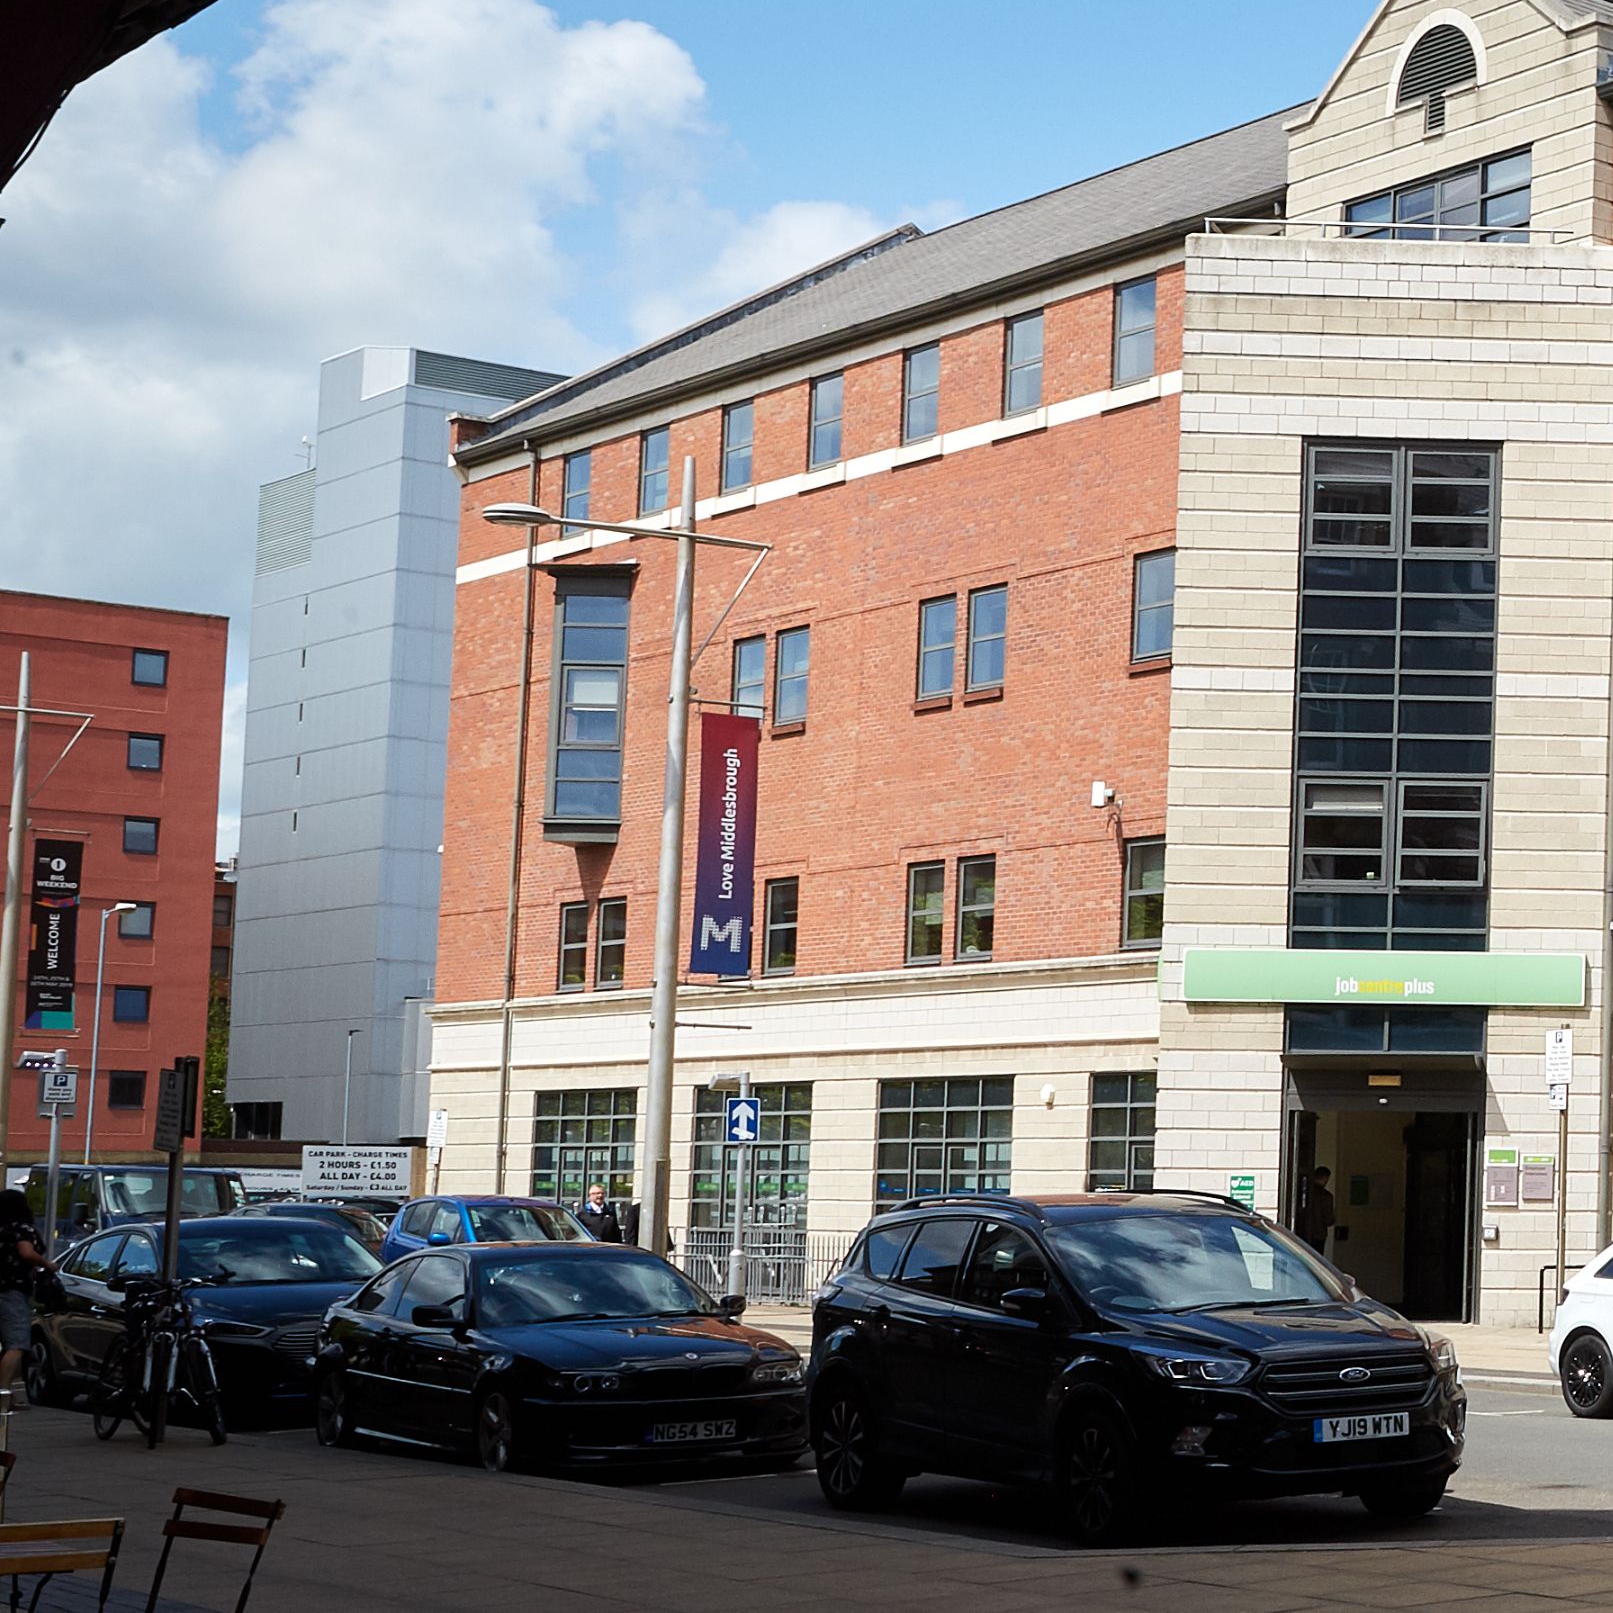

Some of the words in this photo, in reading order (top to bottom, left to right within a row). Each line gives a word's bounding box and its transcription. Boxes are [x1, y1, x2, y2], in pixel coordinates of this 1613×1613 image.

[720, 748, 741, 860] Middlesbrough
[37, 880, 77, 889] WEEKEND
[718, 865, 734, 899] Love
[47, 914, 60, 970] WELCOME
[700, 914, 743, 952] M
[1334, 977, 1435, 997] jobcentreplus
[319, 1161, 325, 1169] 2
[328, 1161, 361, 1169] HOURS
[370, 1161, 397, 1169] £1.50
[320, 1172, 338, 1180] ALL
[342, 1172, 361, 1180] DAY
[370, 1172, 397, 1180] £4.00
[655, 1425, 698, 1440] NG54
[704, 1422, 735, 1437] SWZ
[1329, 1418, 1368, 1438] YJ19
[1372, 1415, 1404, 1434] WTN
